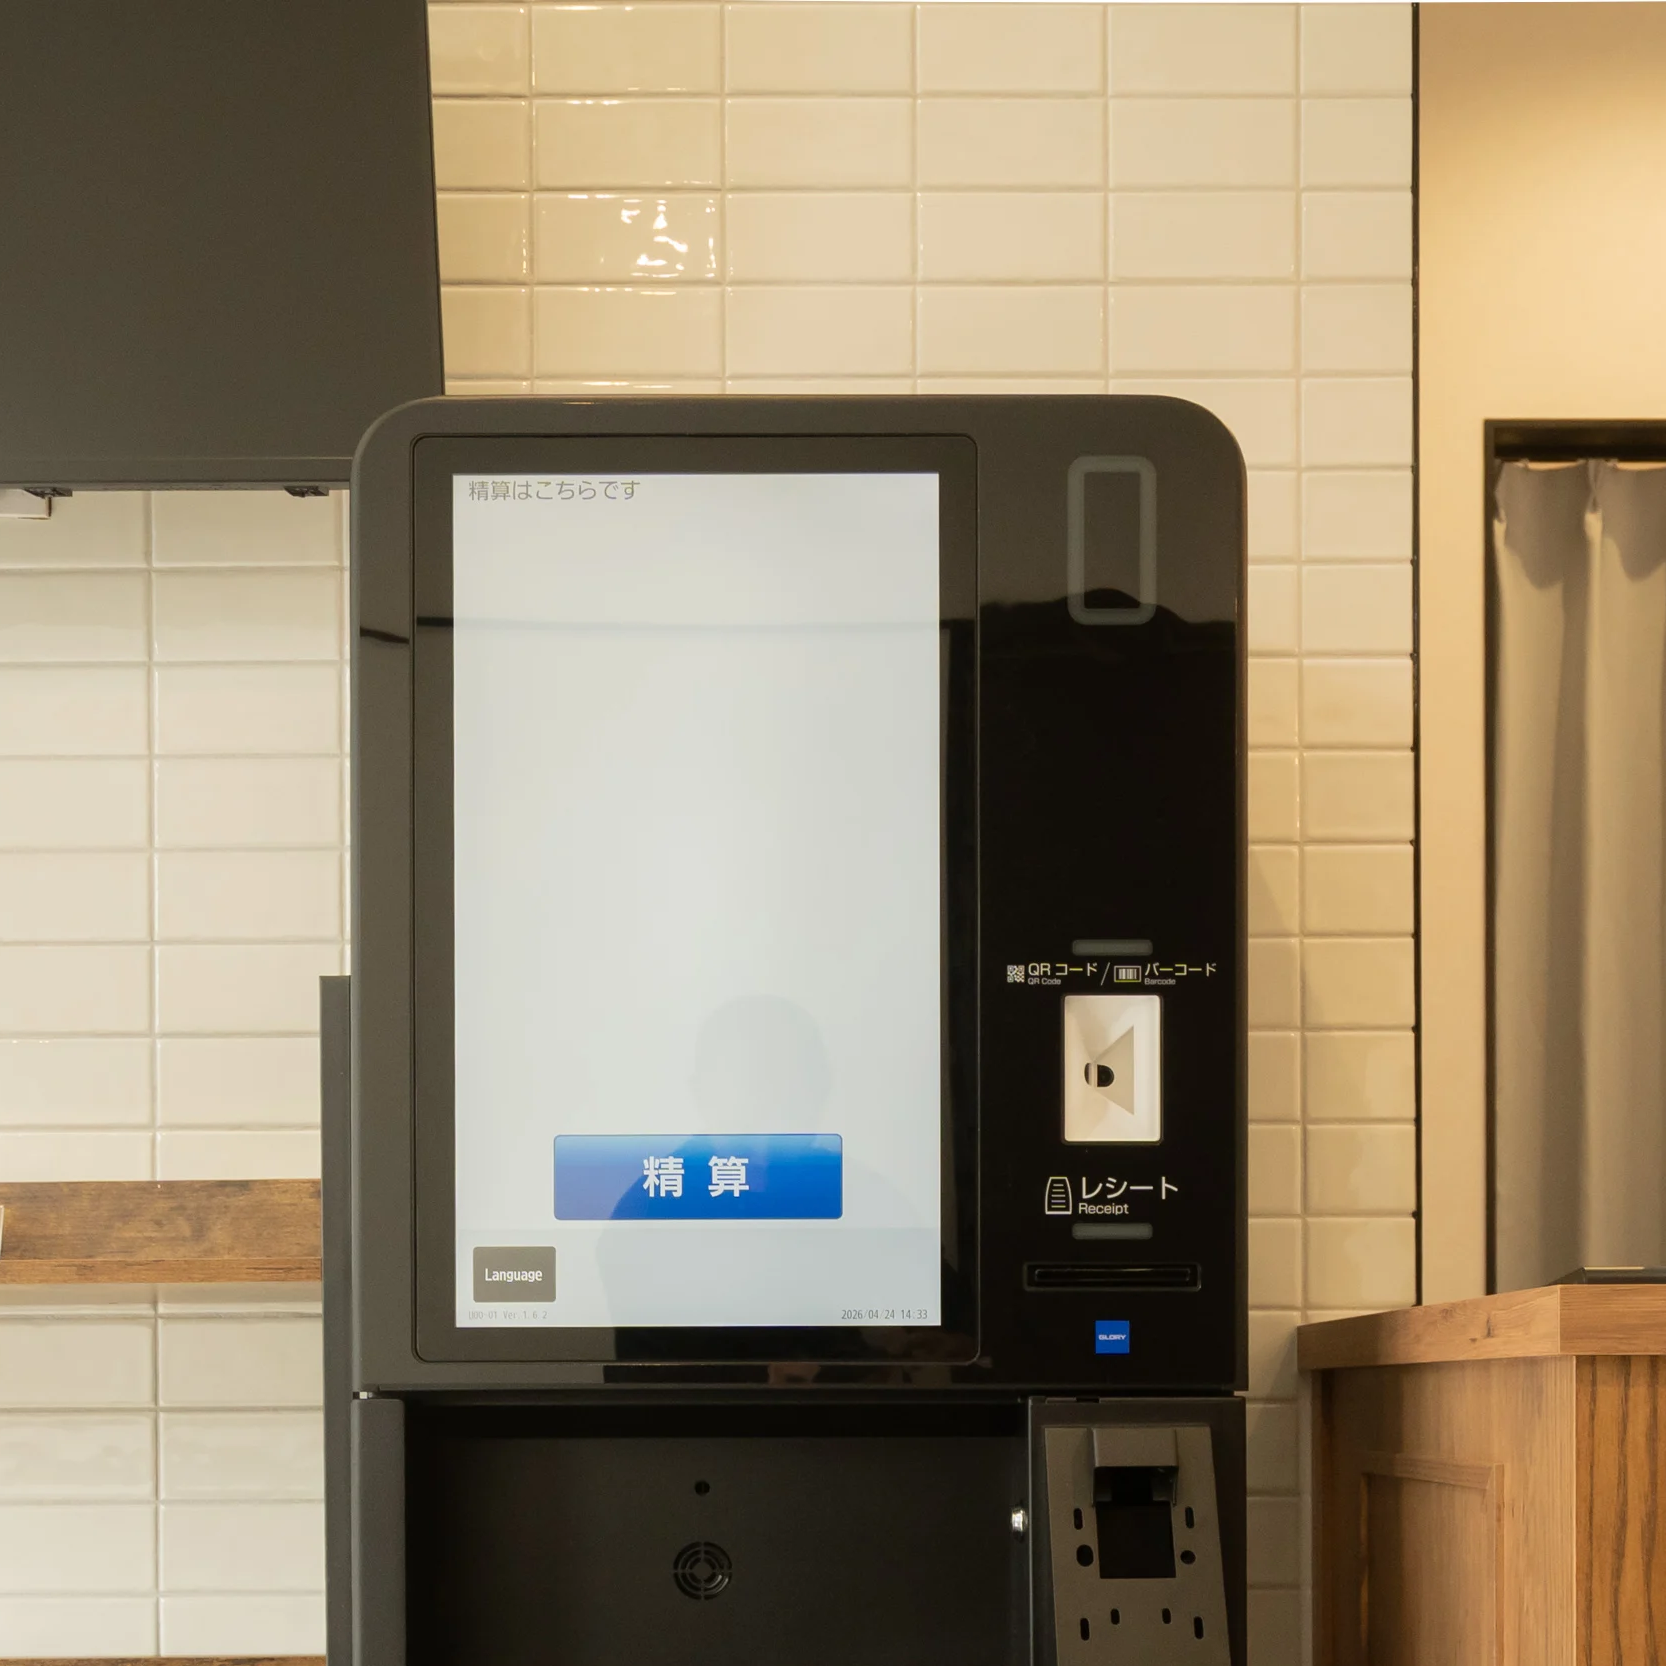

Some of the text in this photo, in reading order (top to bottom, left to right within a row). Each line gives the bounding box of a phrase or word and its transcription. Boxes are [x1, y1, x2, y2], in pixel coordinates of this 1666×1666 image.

[468, 480, 641, 501] 精算はこちらです
[1027, 977, 1062, 985] QR Code
[1144, 977, 1176, 985] Barcode
[642, 1156, 750, 1198] 精算
[1081, 1176, 1179, 1200] レシート
[1078, 1203, 1129, 1215] Receipt
[484, 1267, 543, 1283] Language
[841, 1309, 928, 1320] 2026/04/24 14:33
